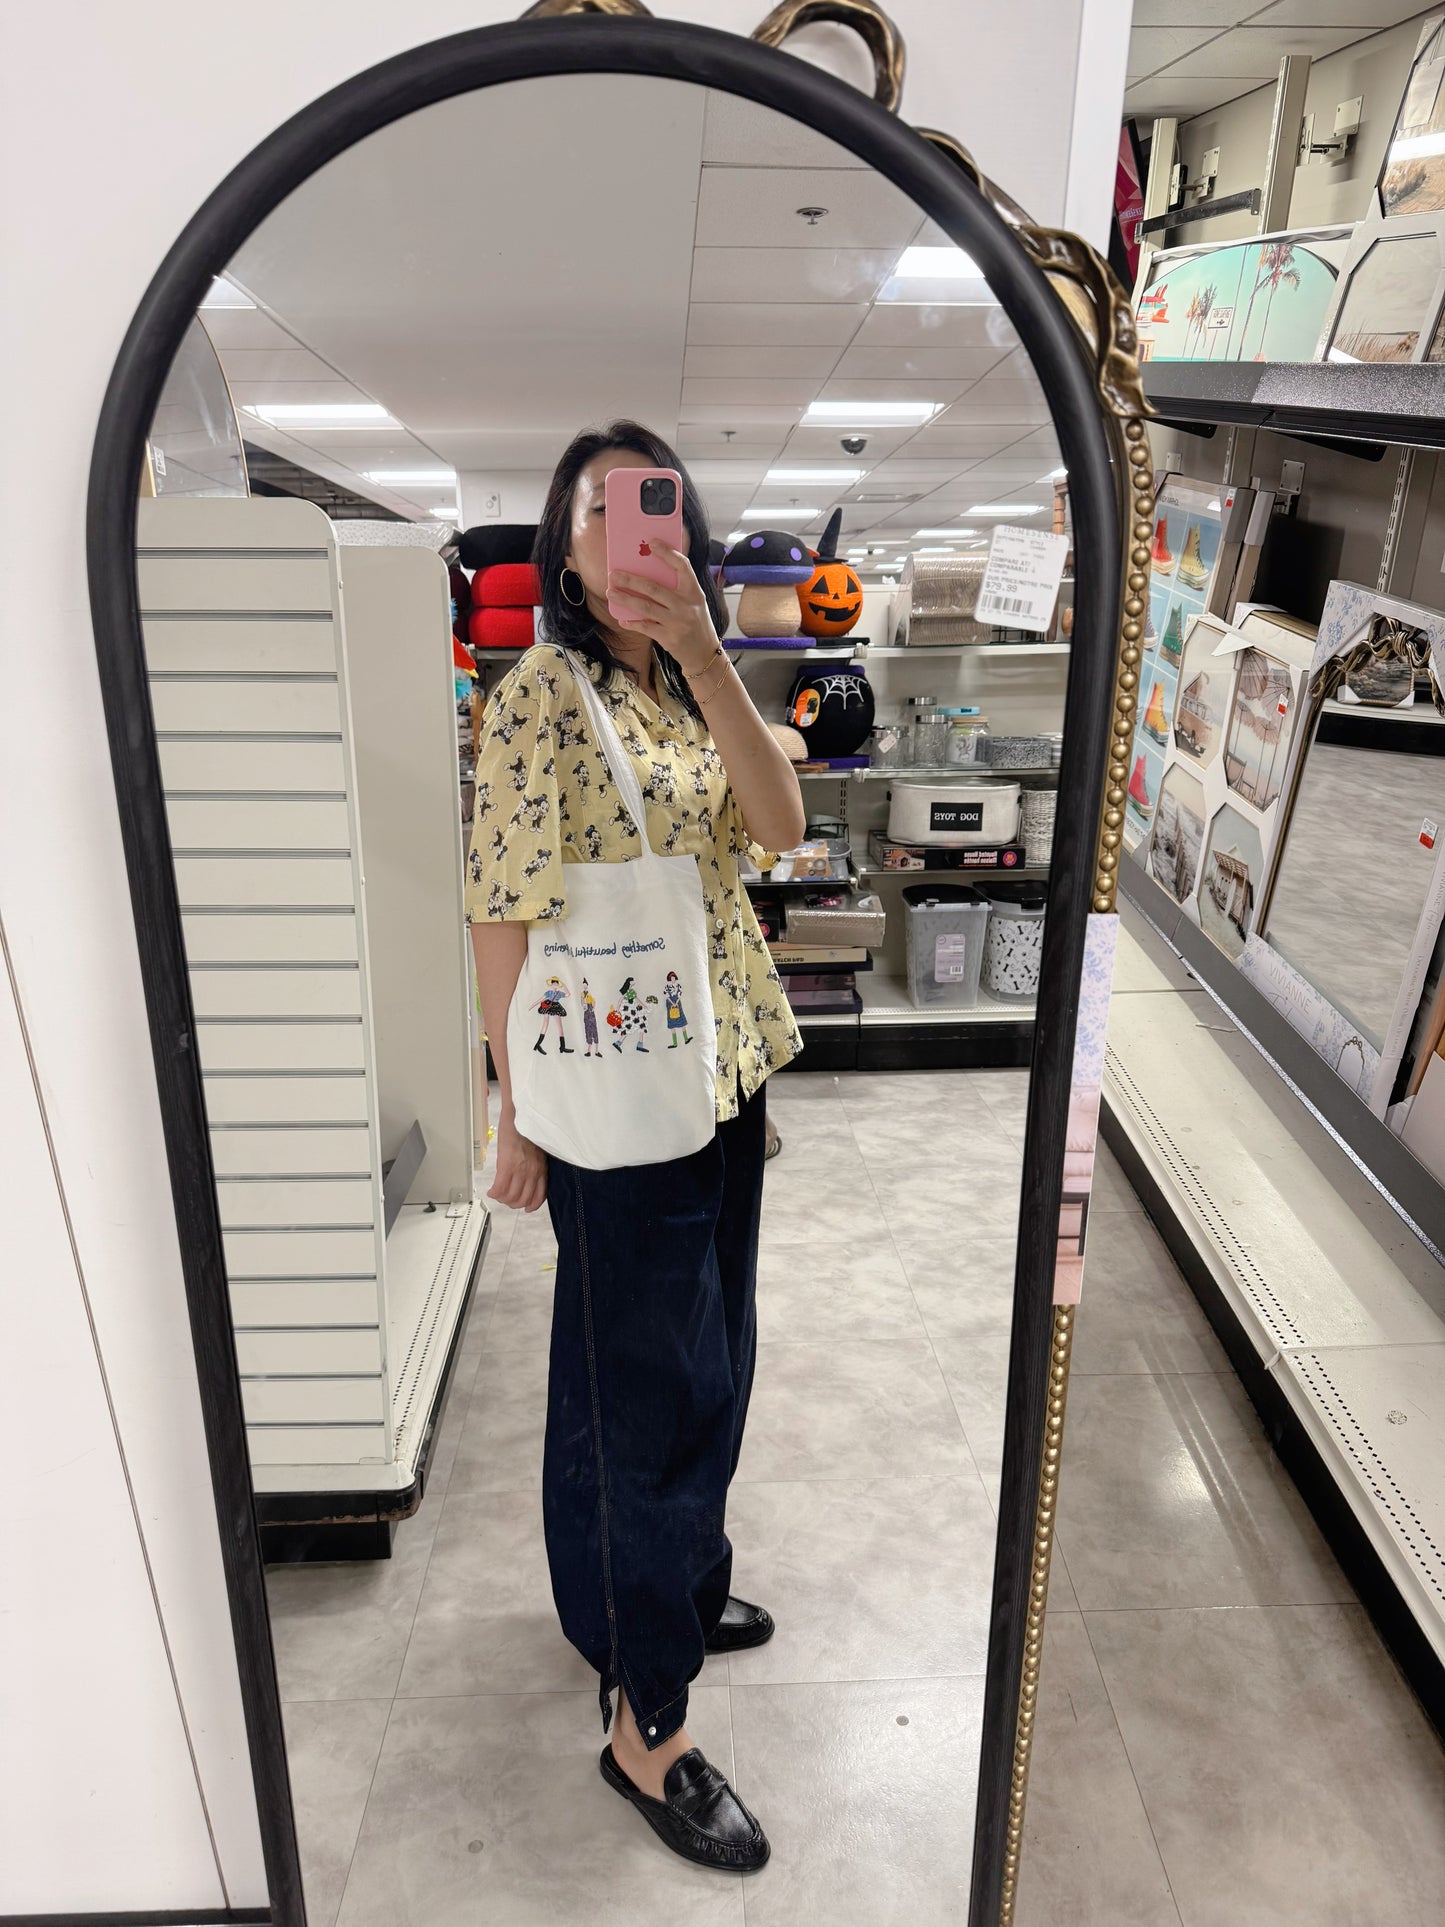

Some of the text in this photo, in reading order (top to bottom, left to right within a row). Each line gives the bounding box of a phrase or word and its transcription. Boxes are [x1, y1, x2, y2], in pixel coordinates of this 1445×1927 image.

[1003, 526, 1060, 541] HOMESENSE
[991, 556, 1019, 566] COMPARE
[990, 562, 1028, 574] COMPARABLE
[985, 581, 1018, 593] $79.99
[1269, 962, 1313, 1015] VIVIANNE
